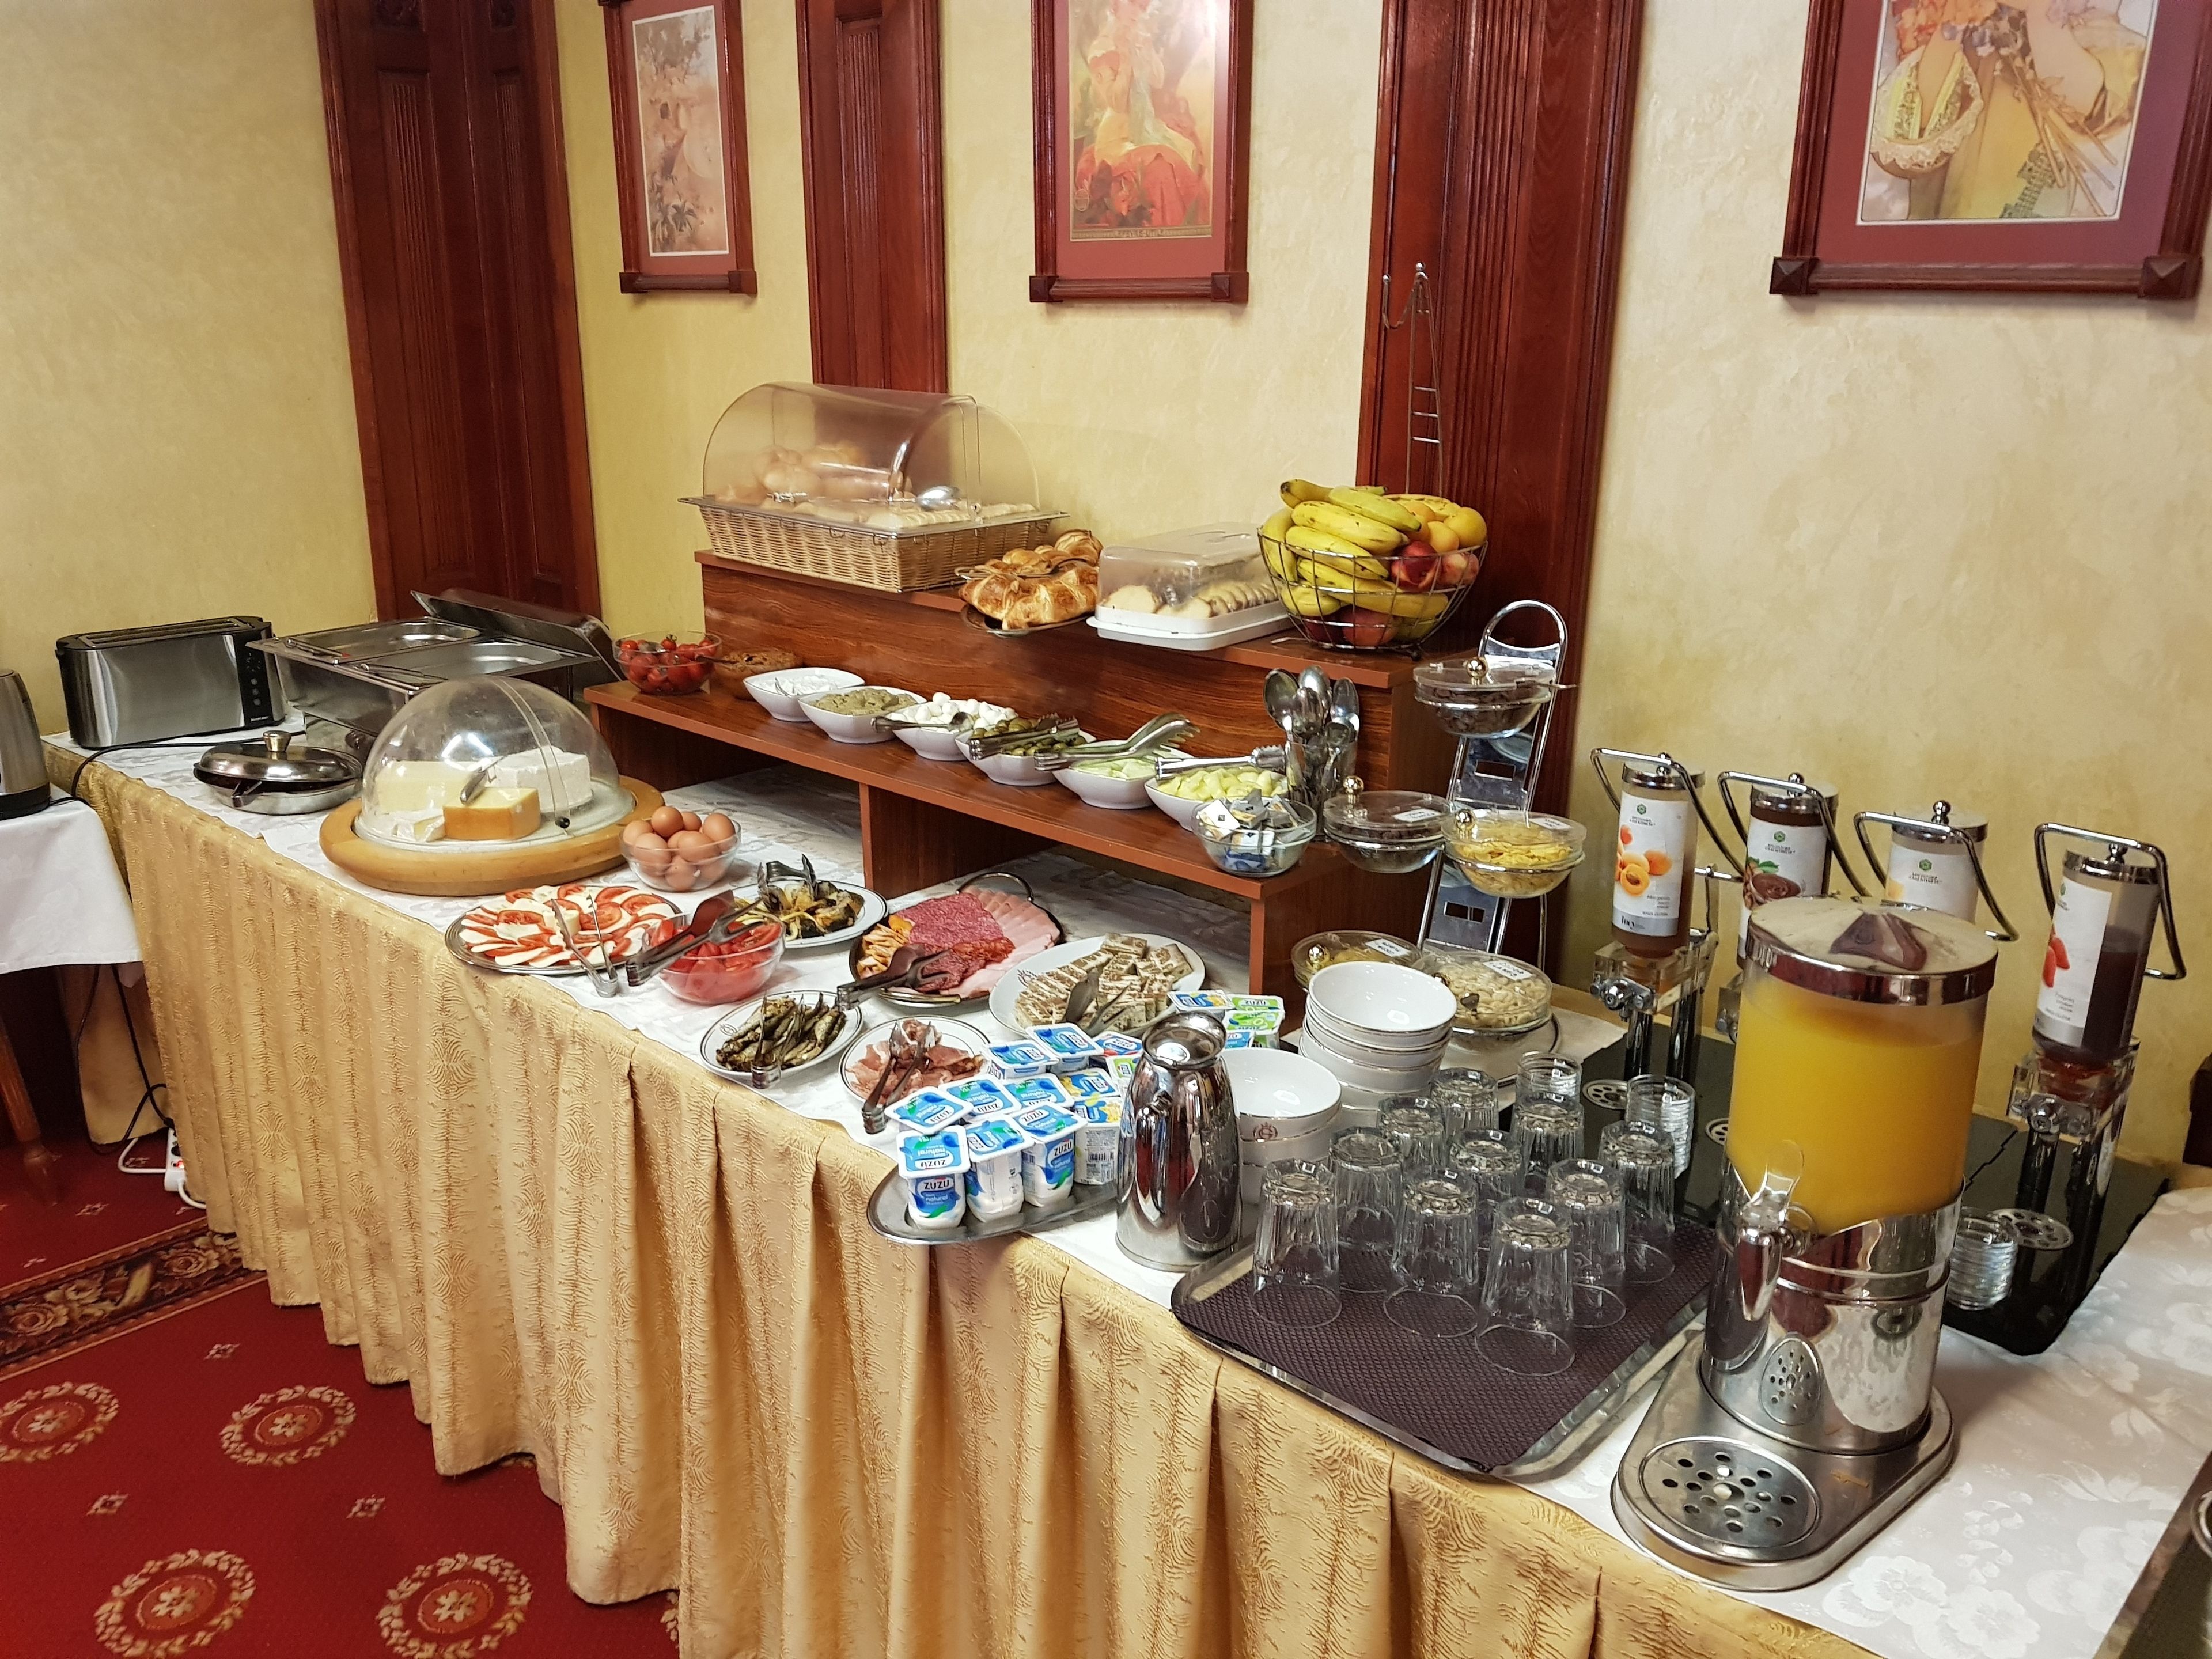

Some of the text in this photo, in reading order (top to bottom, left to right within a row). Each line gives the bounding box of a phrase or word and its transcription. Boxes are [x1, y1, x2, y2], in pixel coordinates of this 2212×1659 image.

[918, 1146, 946, 1157] natural
[1054, 1141, 1072, 1156] ZUZU
[921, 1159, 946, 1168] ZUZU
[924, 1180, 949, 1190] ZUZU
[926, 1194, 948, 1202] natural
